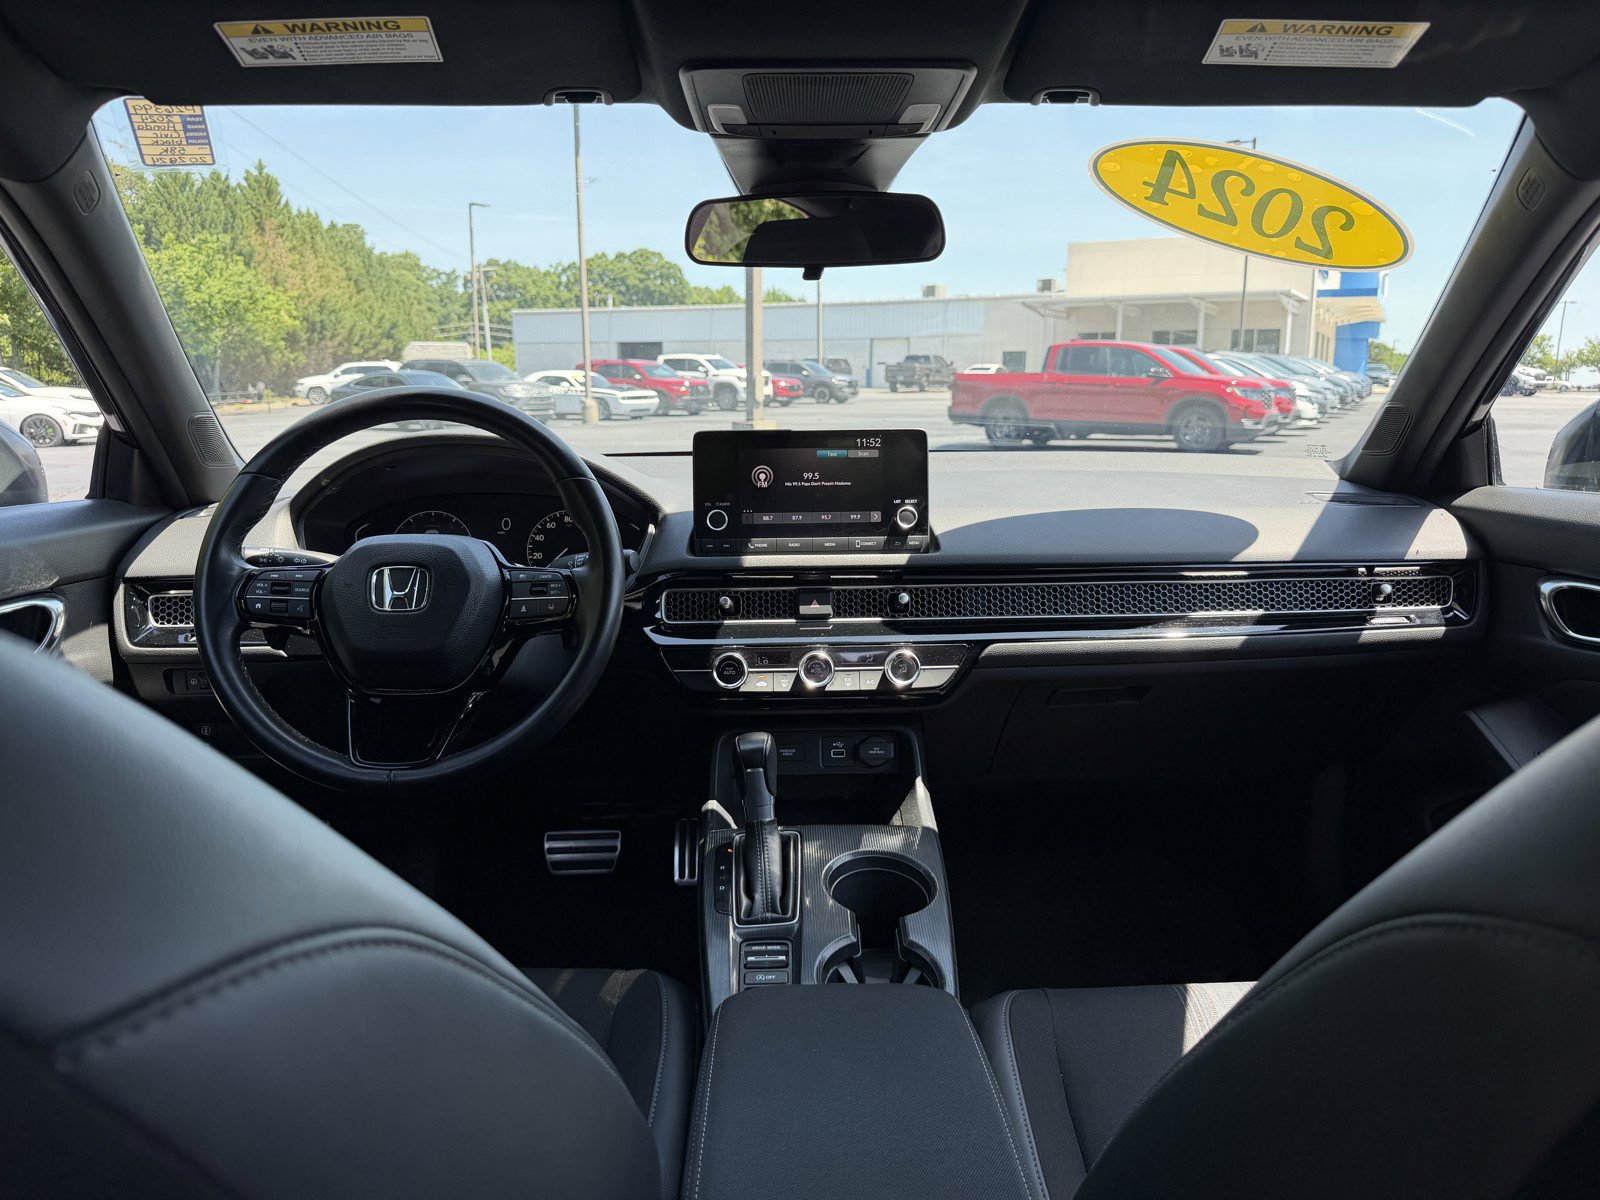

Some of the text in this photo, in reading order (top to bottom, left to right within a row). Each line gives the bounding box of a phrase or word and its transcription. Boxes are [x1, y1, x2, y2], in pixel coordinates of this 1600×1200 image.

[283, 19, 402, 34] WARNING
[1283, 24, 1394, 36] WARNING
[856, 438, 881, 446] 11:52
[501, 518, 511, 530] 0
